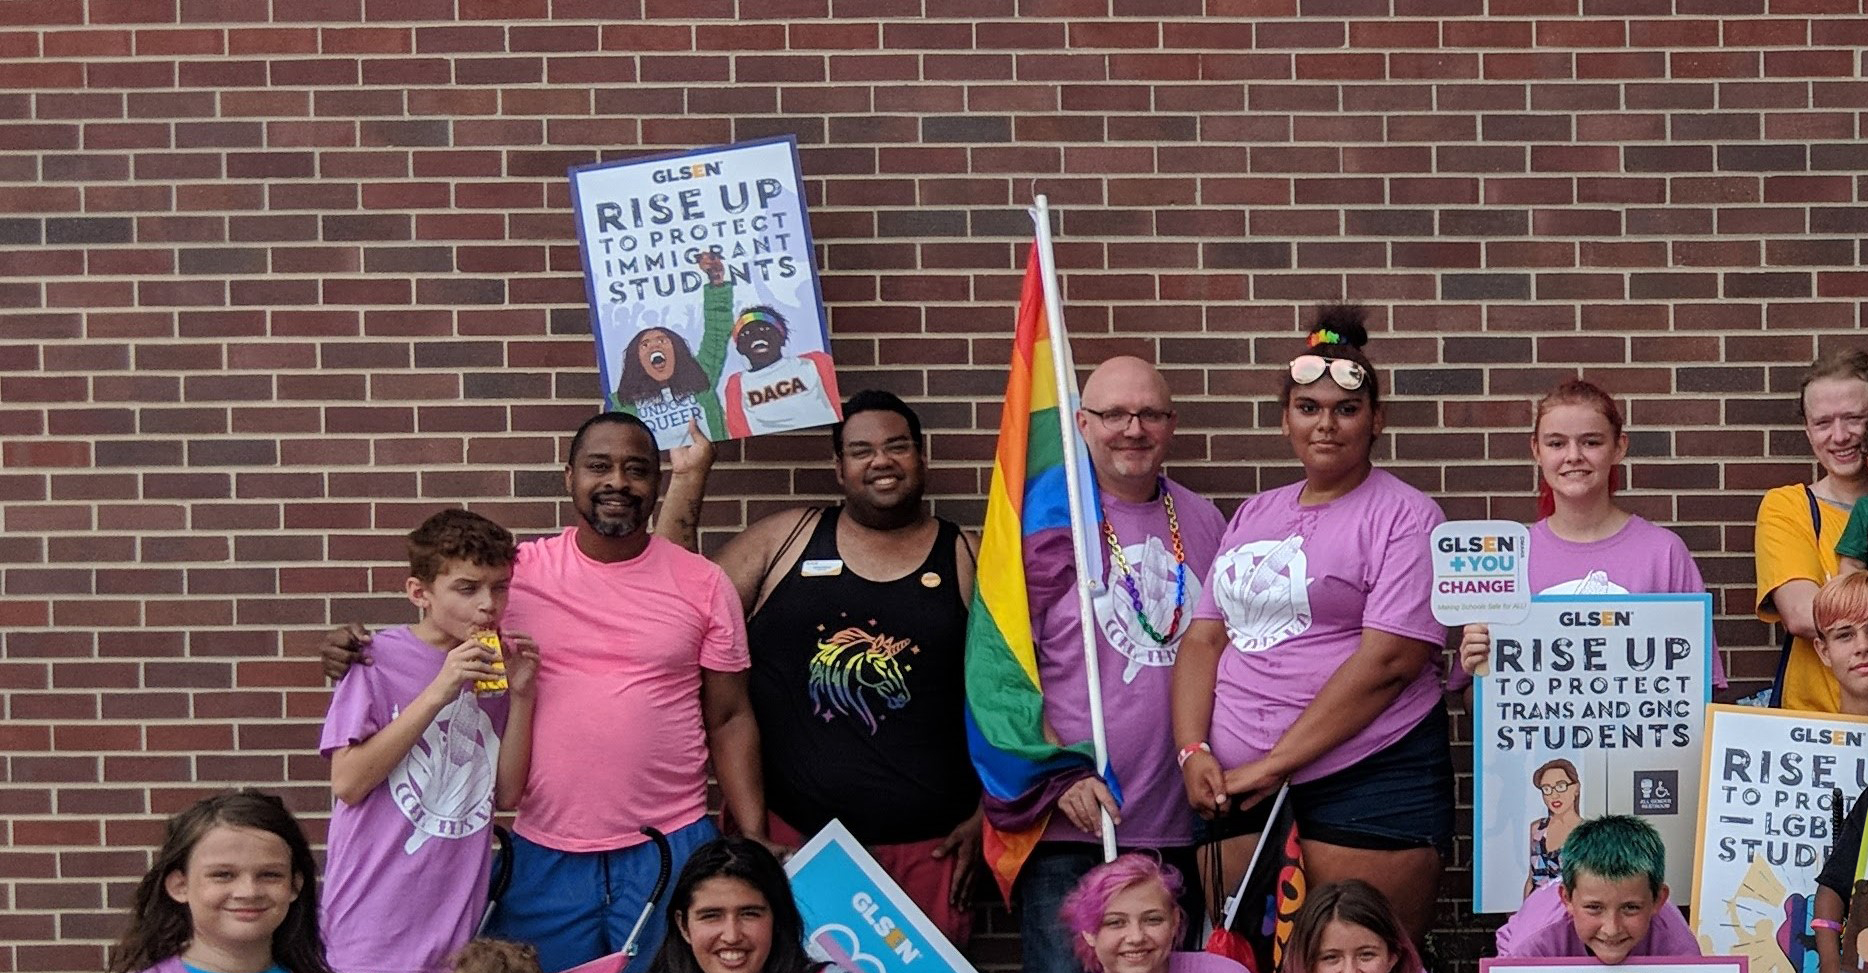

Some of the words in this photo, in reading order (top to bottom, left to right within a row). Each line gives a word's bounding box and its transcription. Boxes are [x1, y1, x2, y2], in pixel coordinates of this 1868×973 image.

[652, 161, 721, 184] GLSEN
[596, 188, 705, 233] RISE
[719, 178, 782, 214] UP
[599, 234, 638, 254] TO
[650, 212, 787, 248] PROTECT
[606, 233, 790, 278] IMMIGRANT
[608, 255, 797, 305] STUDNTS
[747, 377, 808, 407] DACA
[1438, 536, 1514, 553] GLSEN
[1439, 580, 1515, 593] CHANGE
[1559, 611, 1631, 627] GLSEN
[1496, 637, 1607, 672] RISE
[1625, 637, 1691, 672] UP
[1496, 678, 1535, 695] TO
[1549, 676, 1691, 695] PROTECT
[1497, 701, 1575, 720] TRANS
[1582, 700, 1631, 720] AND
[1639, 700, 1690, 719] GNC
[1497, 724, 1691, 751] STUDENTS
[1790, 727, 1863, 747] GLSEN
[1723, 748, 1837, 789] RISE
[1722, 786, 1761, 806] TO
[1775, 789, 1858, 813] PROT
[1765, 812, 1830, 838] LGB
[1718, 837, 1833, 867] STUD
[852, 892, 921, 964] GLSEN
